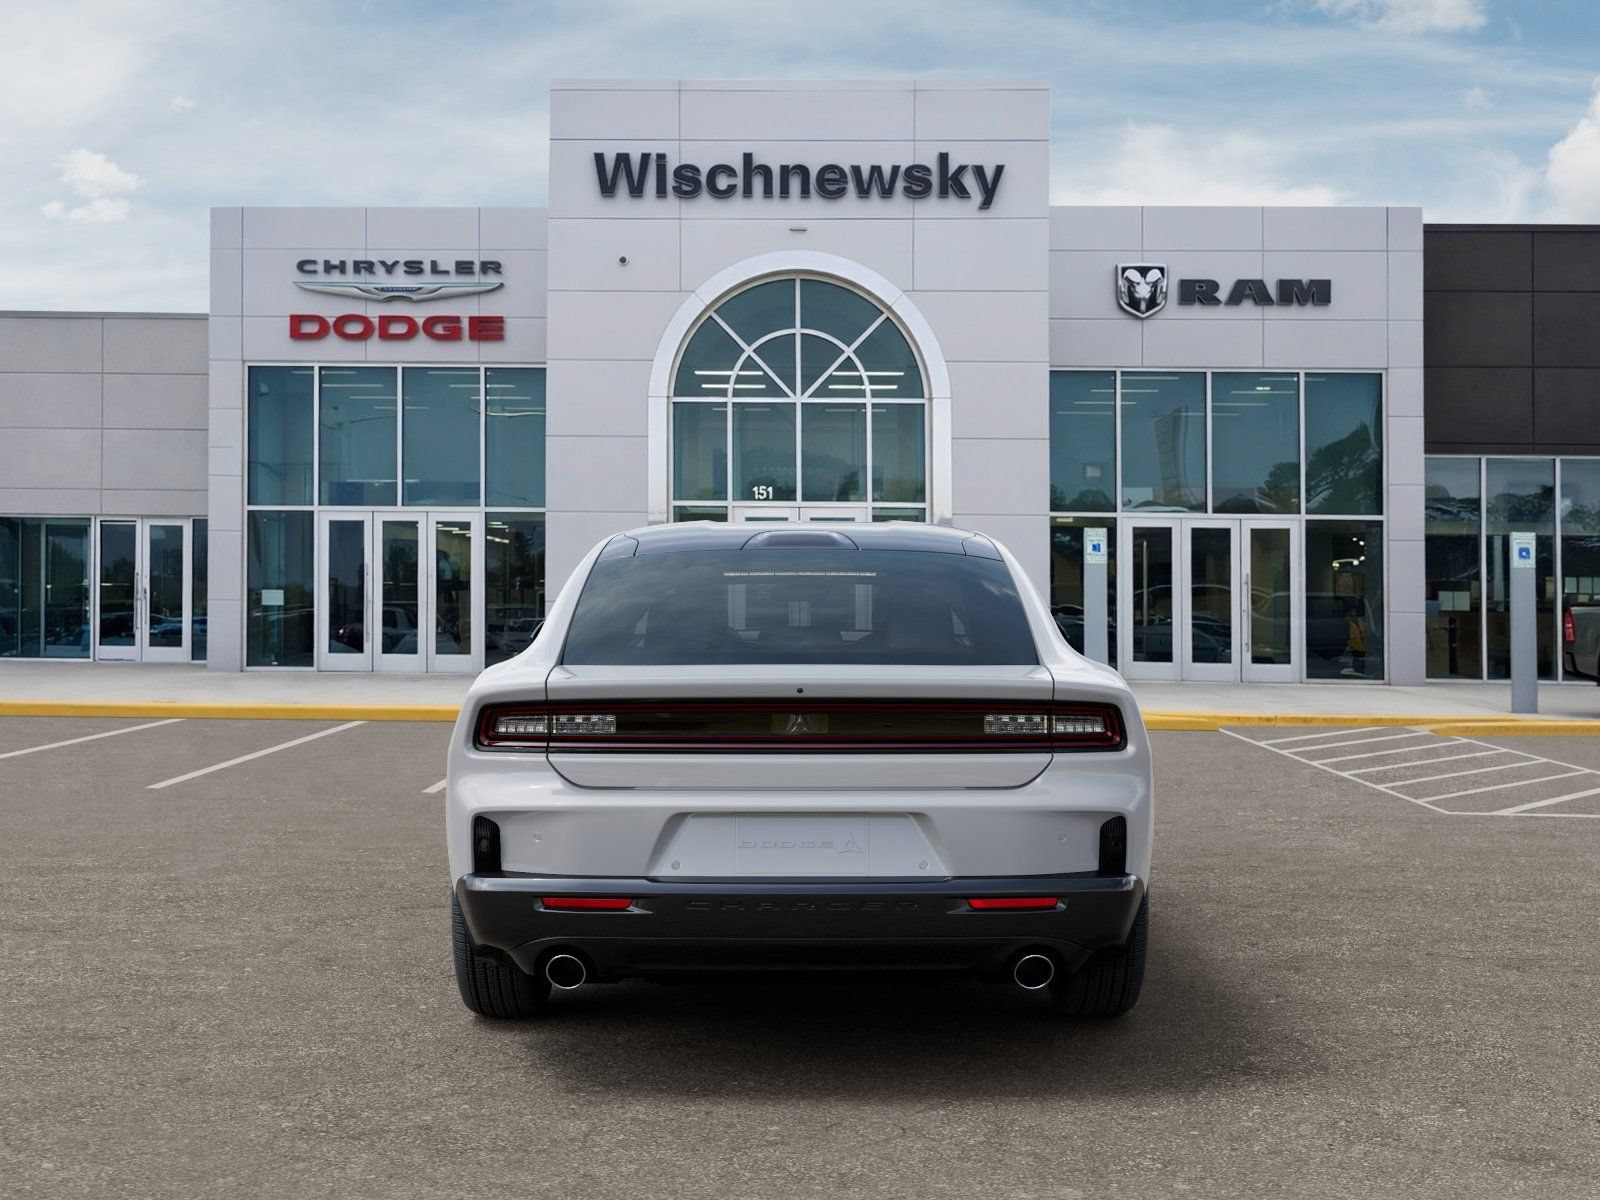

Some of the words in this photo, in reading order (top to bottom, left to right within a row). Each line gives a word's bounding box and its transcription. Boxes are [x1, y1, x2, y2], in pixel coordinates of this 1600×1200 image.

[594, 152, 1005, 210] Wischnewsky
[296, 259, 503, 275] CHRYSLER
[1177, 278, 1332, 306] RAM
[289, 314, 505, 341] DODGE
[752, 485, 773, 500] 151
[738, 839, 834, 849] DODGE
[685, 901, 920, 911] CHARGER
